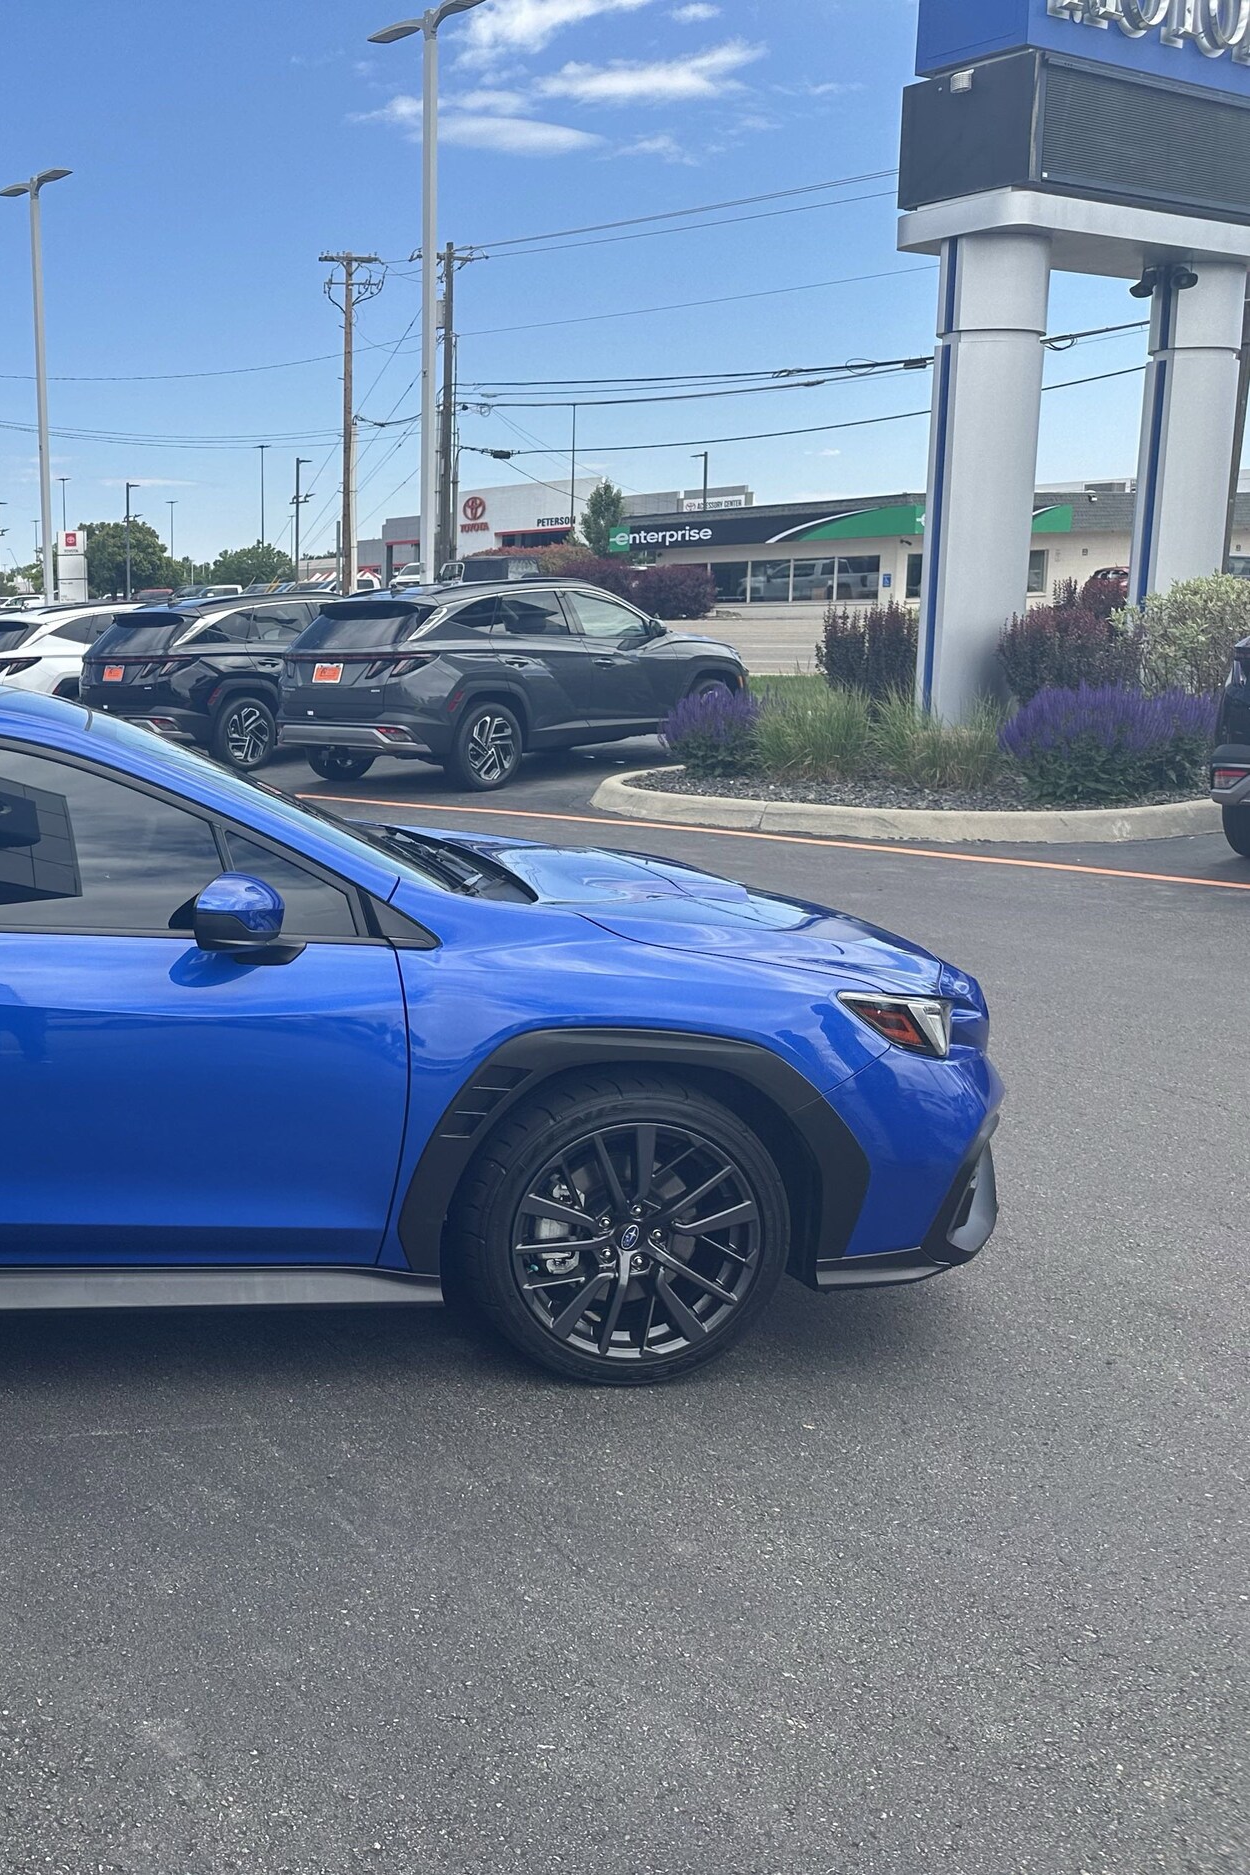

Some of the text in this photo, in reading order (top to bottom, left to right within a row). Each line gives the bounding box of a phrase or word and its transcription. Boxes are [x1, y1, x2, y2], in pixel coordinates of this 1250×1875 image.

[724, 500, 742, 508] CENTER
[460, 522, 489, 533] TOYOTA
[615, 526, 712, 546] enterprise
